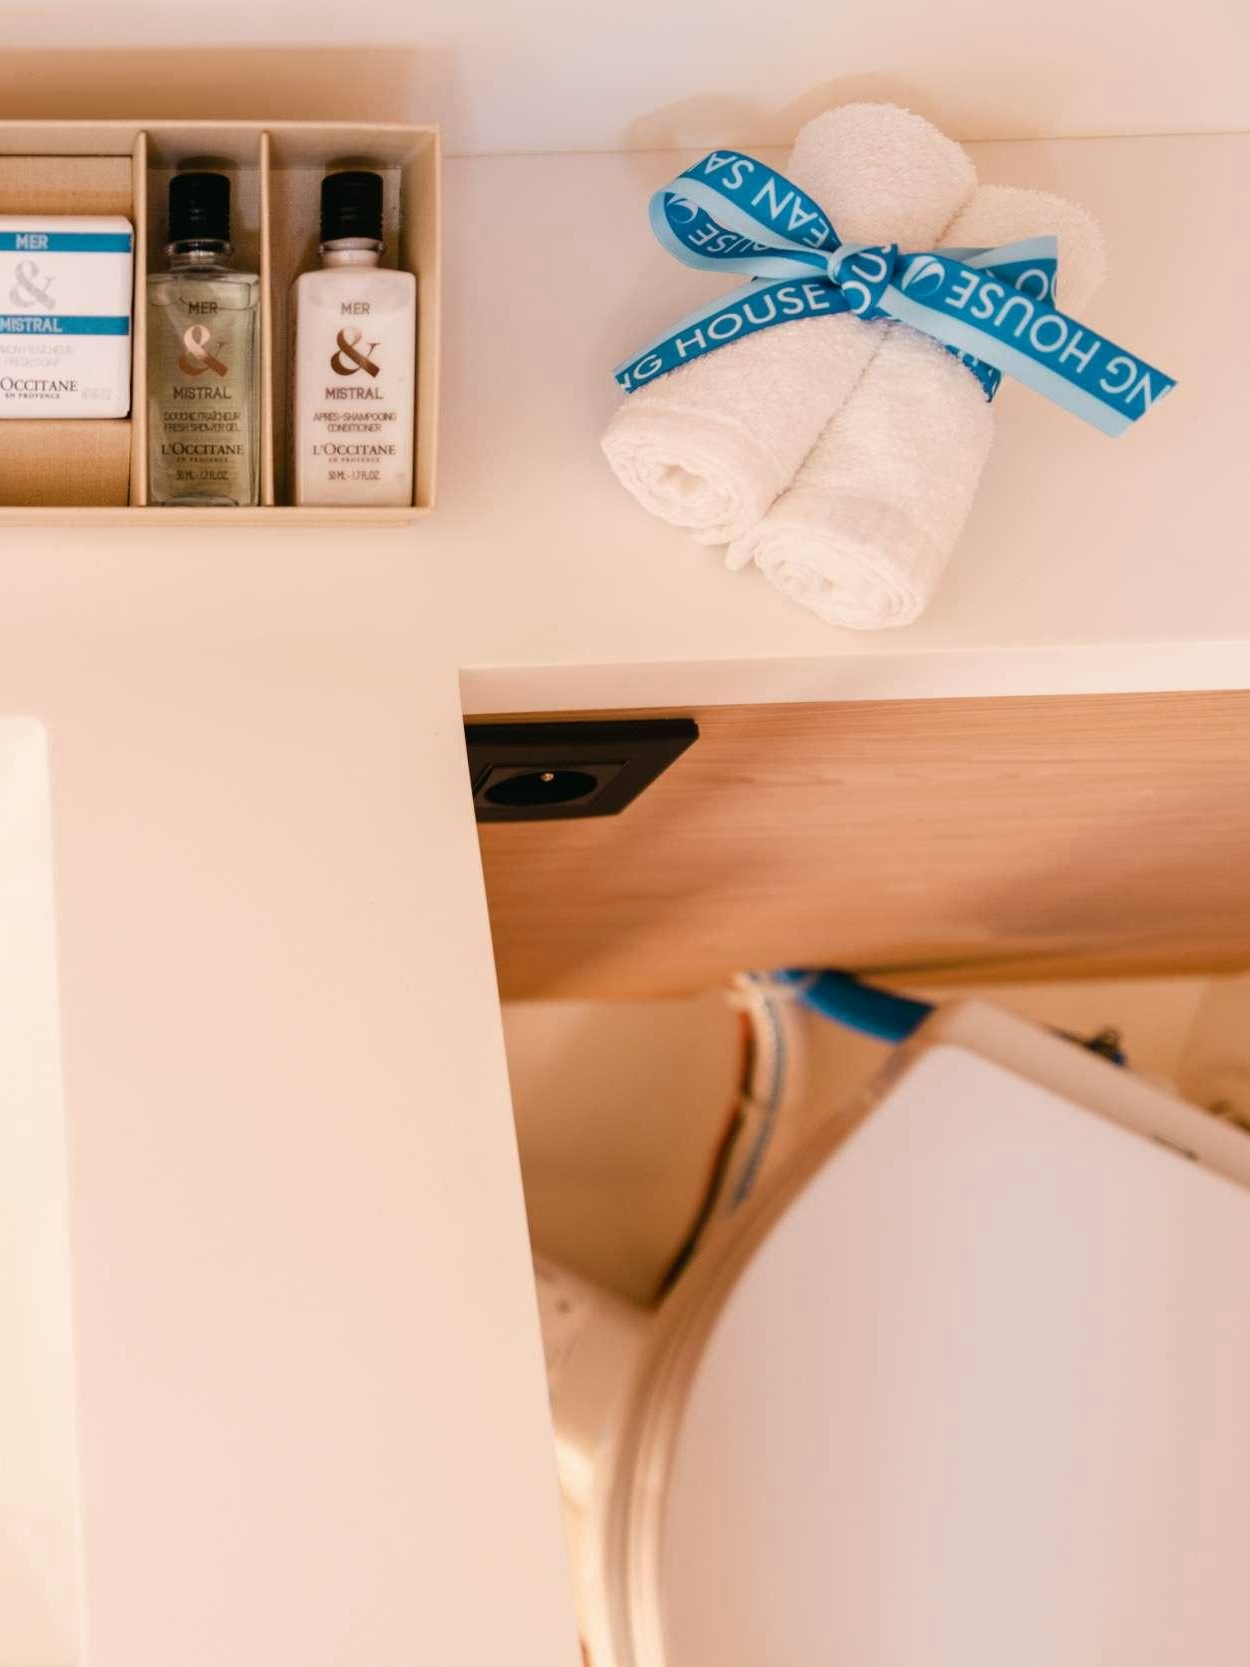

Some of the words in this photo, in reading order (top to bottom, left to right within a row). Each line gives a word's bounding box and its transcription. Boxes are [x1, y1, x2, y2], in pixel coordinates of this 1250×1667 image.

[16, 234, 48, 250] MER
[10, 260, 56, 310] &
[188, 302, 218, 314] MER
[341, 303, 370, 315] MER
[0, 317, 62, 333] MISTRAL
[676, 284, 830, 357] HOUSE
[945, 270, 1100, 372] HOUSE
[178, 324, 229, 377] &
[330, 326, 380, 378] &
[173, 387, 232, 399] MISTRAL
[325, 387, 384, 400] MISTRAL
[327, 423, 382, 432] CONDITIONER
